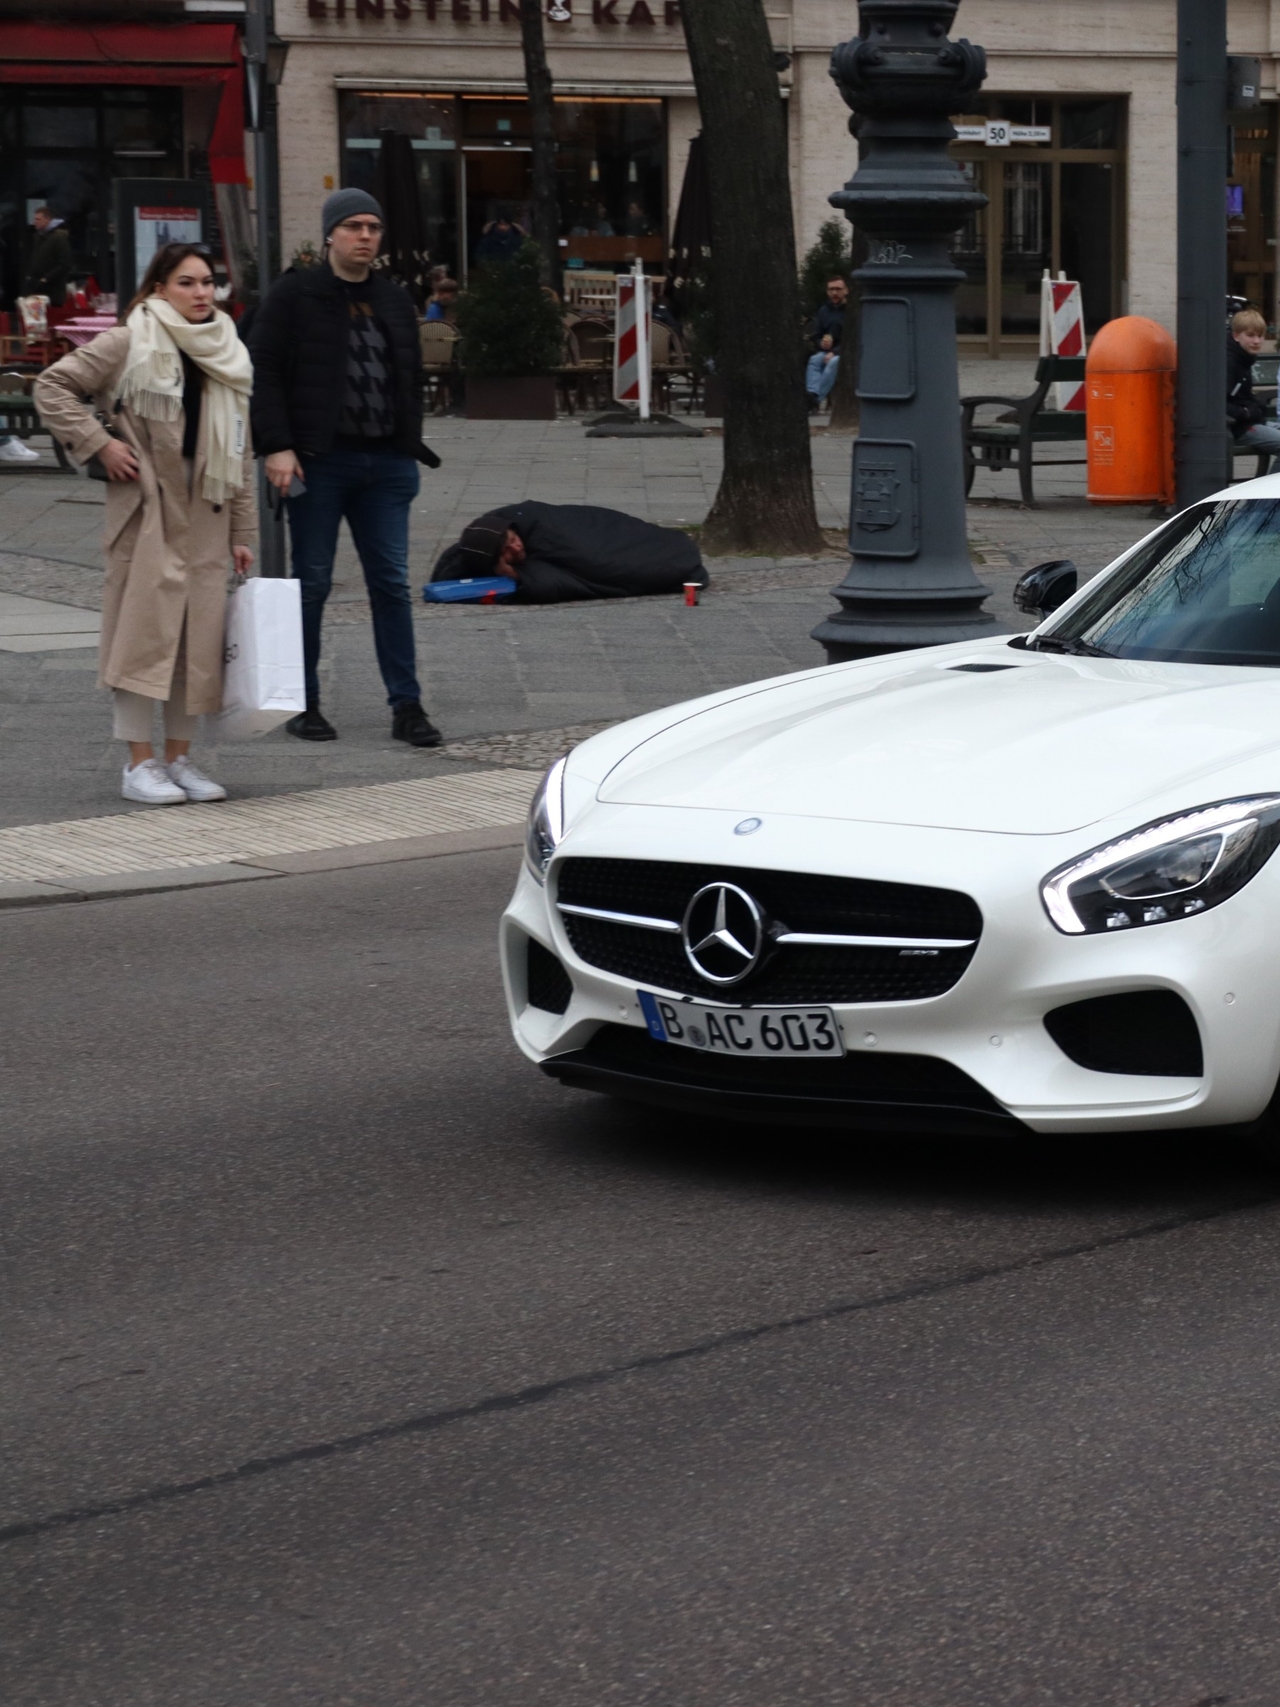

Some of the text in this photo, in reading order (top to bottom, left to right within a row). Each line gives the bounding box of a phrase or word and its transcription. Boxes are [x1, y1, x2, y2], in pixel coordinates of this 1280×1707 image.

[990, 128, 1005, 139] 50
[658, 1002, 835, 1051] B AC 603
